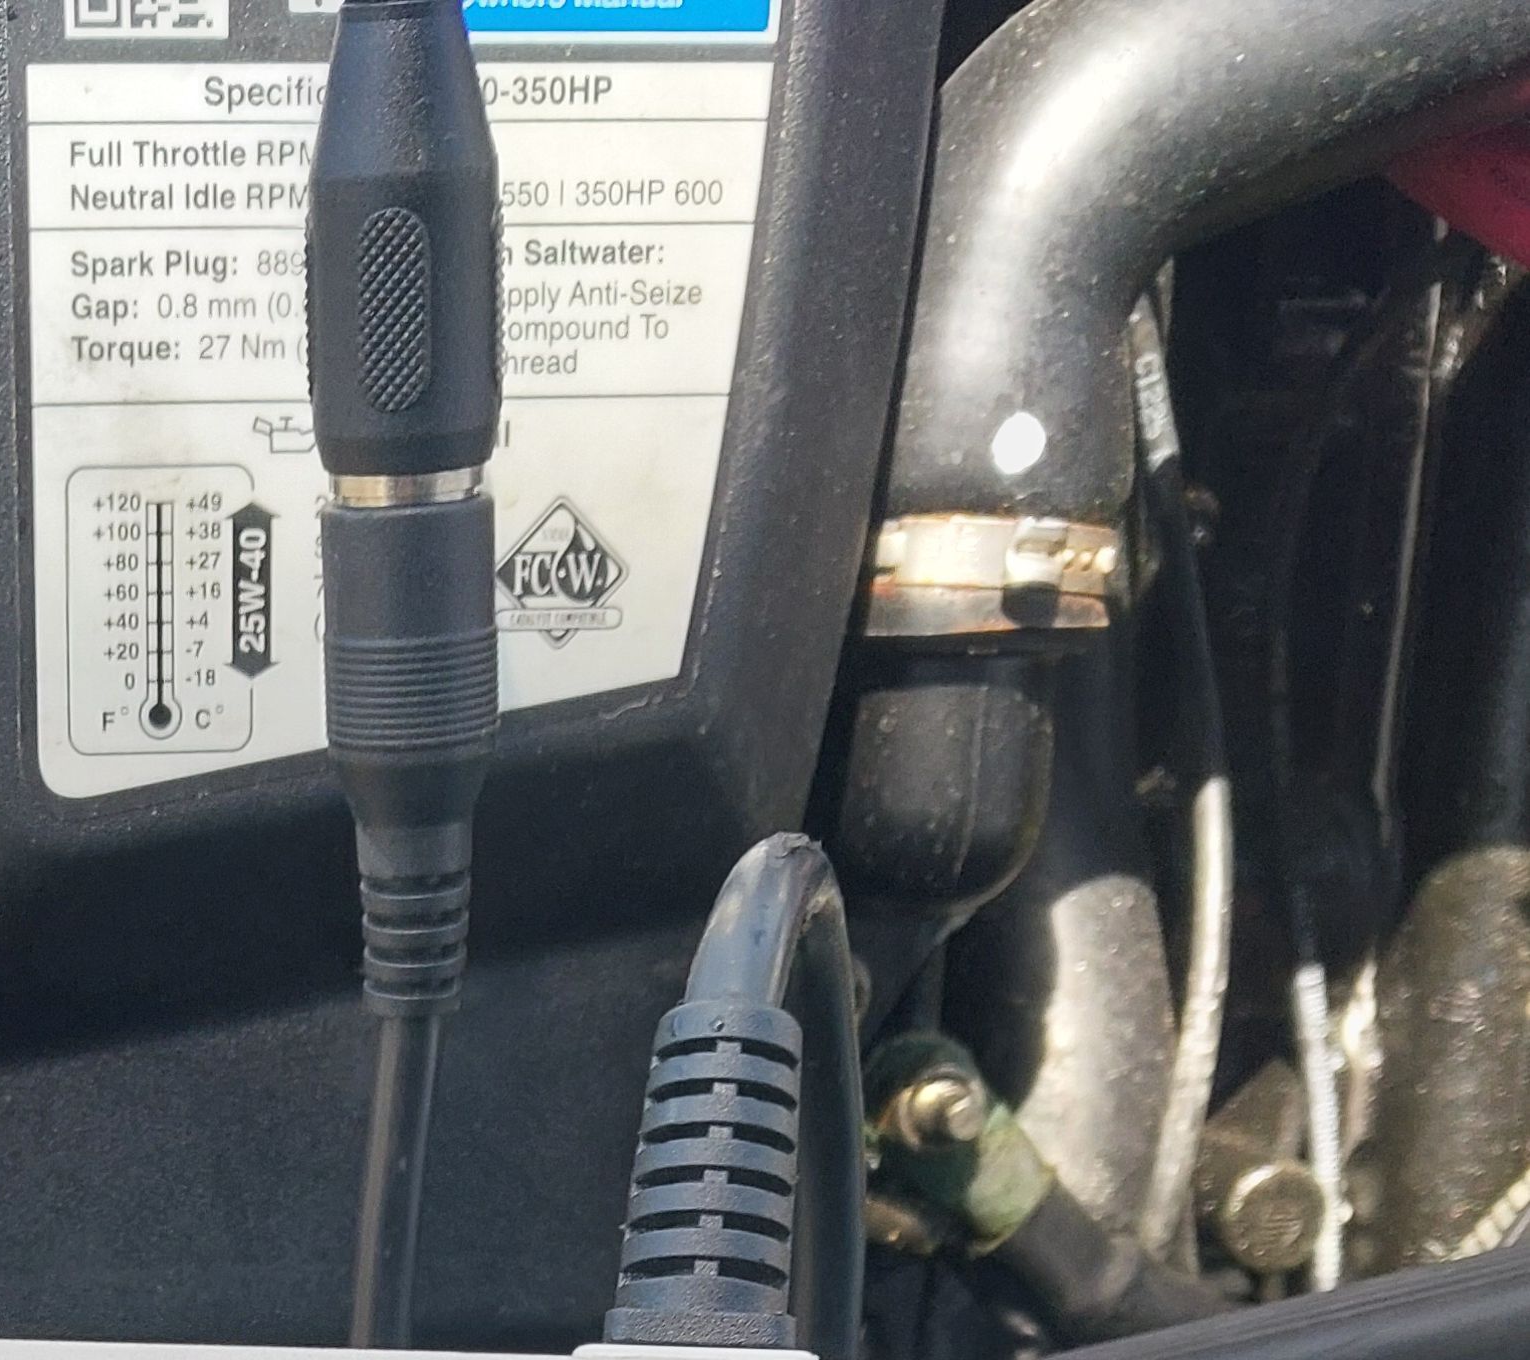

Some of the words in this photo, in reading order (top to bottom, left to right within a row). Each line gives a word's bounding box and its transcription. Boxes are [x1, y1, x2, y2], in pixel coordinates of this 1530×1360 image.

[203, 75, 327, 115] Specific
[482, 74, 613, 106] 0-350HP
[70, 140, 122, 168] Full
[133, 139, 247, 168] Throttle
[70, 182, 174, 211] Neutral
[185, 182, 237, 210] Idle
[575, 179, 666, 207] 350HP
[674, 179, 724, 206] 600
[523, 238, 665, 267] Saltwater:
[70, 250, 155, 285] Spark
[165, 249, 239, 283] Plug:
[256, 249, 308, 277] 889
[506, 281, 562, 314] pply
[569, 278, 704, 307] Anti-Seize
[71, 292, 139, 327] Gap:
[157, 292, 198, 320] 0.8
[208, 296, 257, 319] mm
[506, 315, 631, 348] ompound
[640, 313, 670, 341] To
[70, 335, 181, 368] Torque:
[198, 334, 231, 361] 27
[241, 333, 286, 361] Nm
[93, 493, 142, 513] +120
[185, 493, 223, 512] +49
[93, 522, 142, 542] +100
[185, 522, 222, 541] +38
[103, 553, 139, 572] +80
[185, 552, 222, 571] +27
[104, 583, 139, 602] +60
[185, 581, 222, 600] +16
[237, 527, 268, 654] 25W-40
[103, 613, 140, 631] +40
[185, 611, 210, 630] +4
[103, 642, 140, 661] +20
[185, 640, 205, 659] -7
[124, 672, 136, 691] 0
[185, 669, 216, 687] -18
